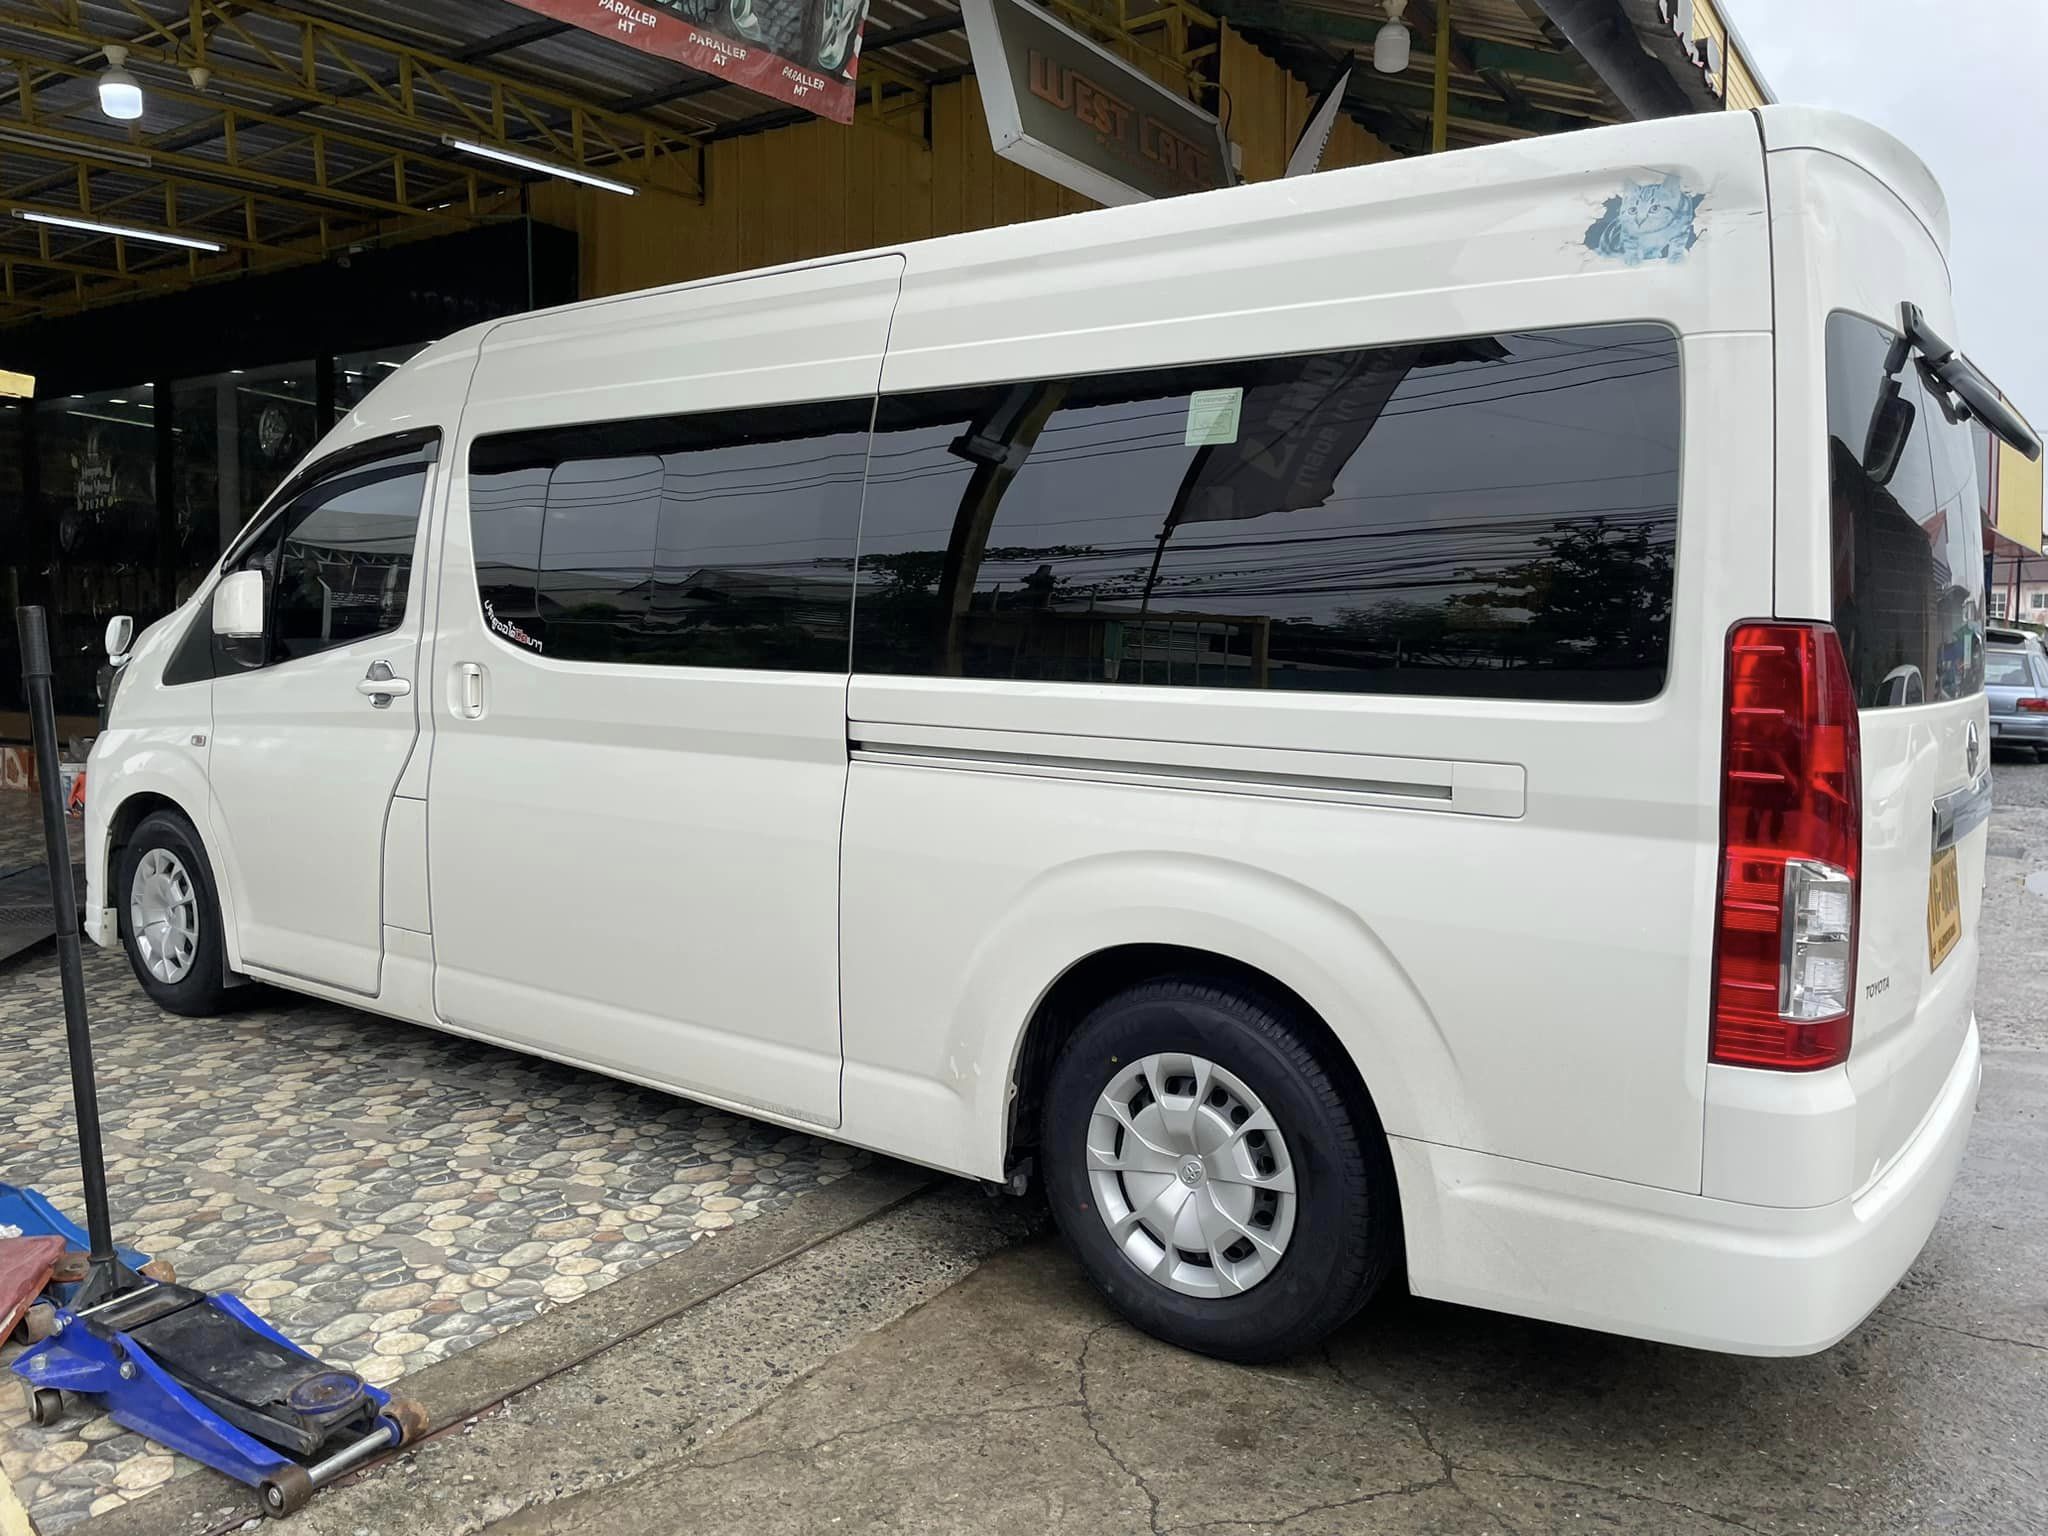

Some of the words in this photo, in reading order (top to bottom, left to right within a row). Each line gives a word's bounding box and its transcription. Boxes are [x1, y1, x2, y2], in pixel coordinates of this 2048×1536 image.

[598, 0, 657, 28] PARALLER
[618, 18, 636, 34] HT
[689, 32, 747, 61] PARALLER
[712, 53, 727, 67] AT
[782, 66, 825, 91] PARALLER
[793, 84, 808, 97] MT
[1029, 49, 1135, 141] WEST
[1865, 976, 1889, 1000] TOYOTA
